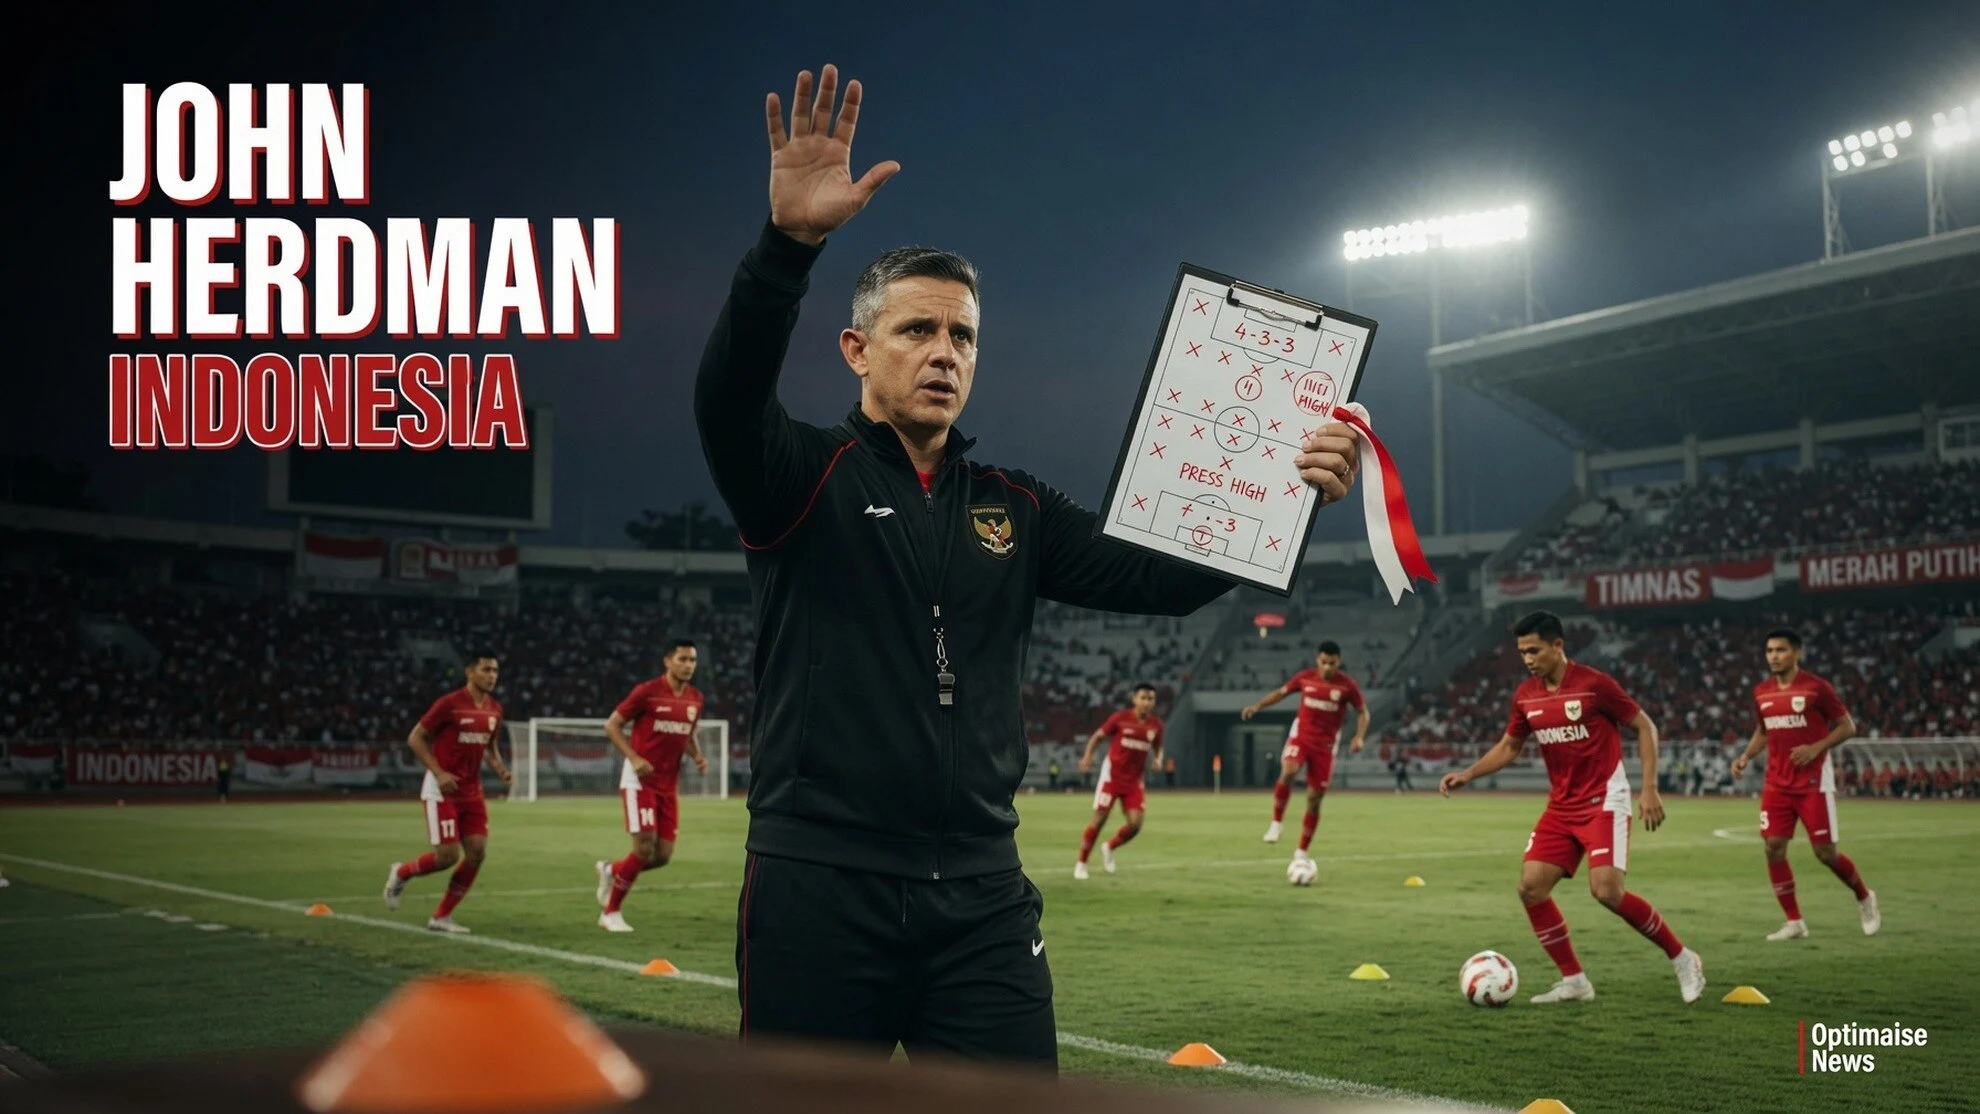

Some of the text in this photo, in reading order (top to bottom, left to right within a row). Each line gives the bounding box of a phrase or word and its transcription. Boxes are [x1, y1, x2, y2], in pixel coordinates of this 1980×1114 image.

[1234, 322, 1295, 353] 4-3-3
[1298, 394, 1329, 418] HIGH
[1179, 462, 1268, 503] PRESS HIGH
[1807, 545, 1980, 586] MERAH PUTIH
[1594, 569, 1701, 605] TIMNAS
[76, 753, 218, 783] INDONESIA
